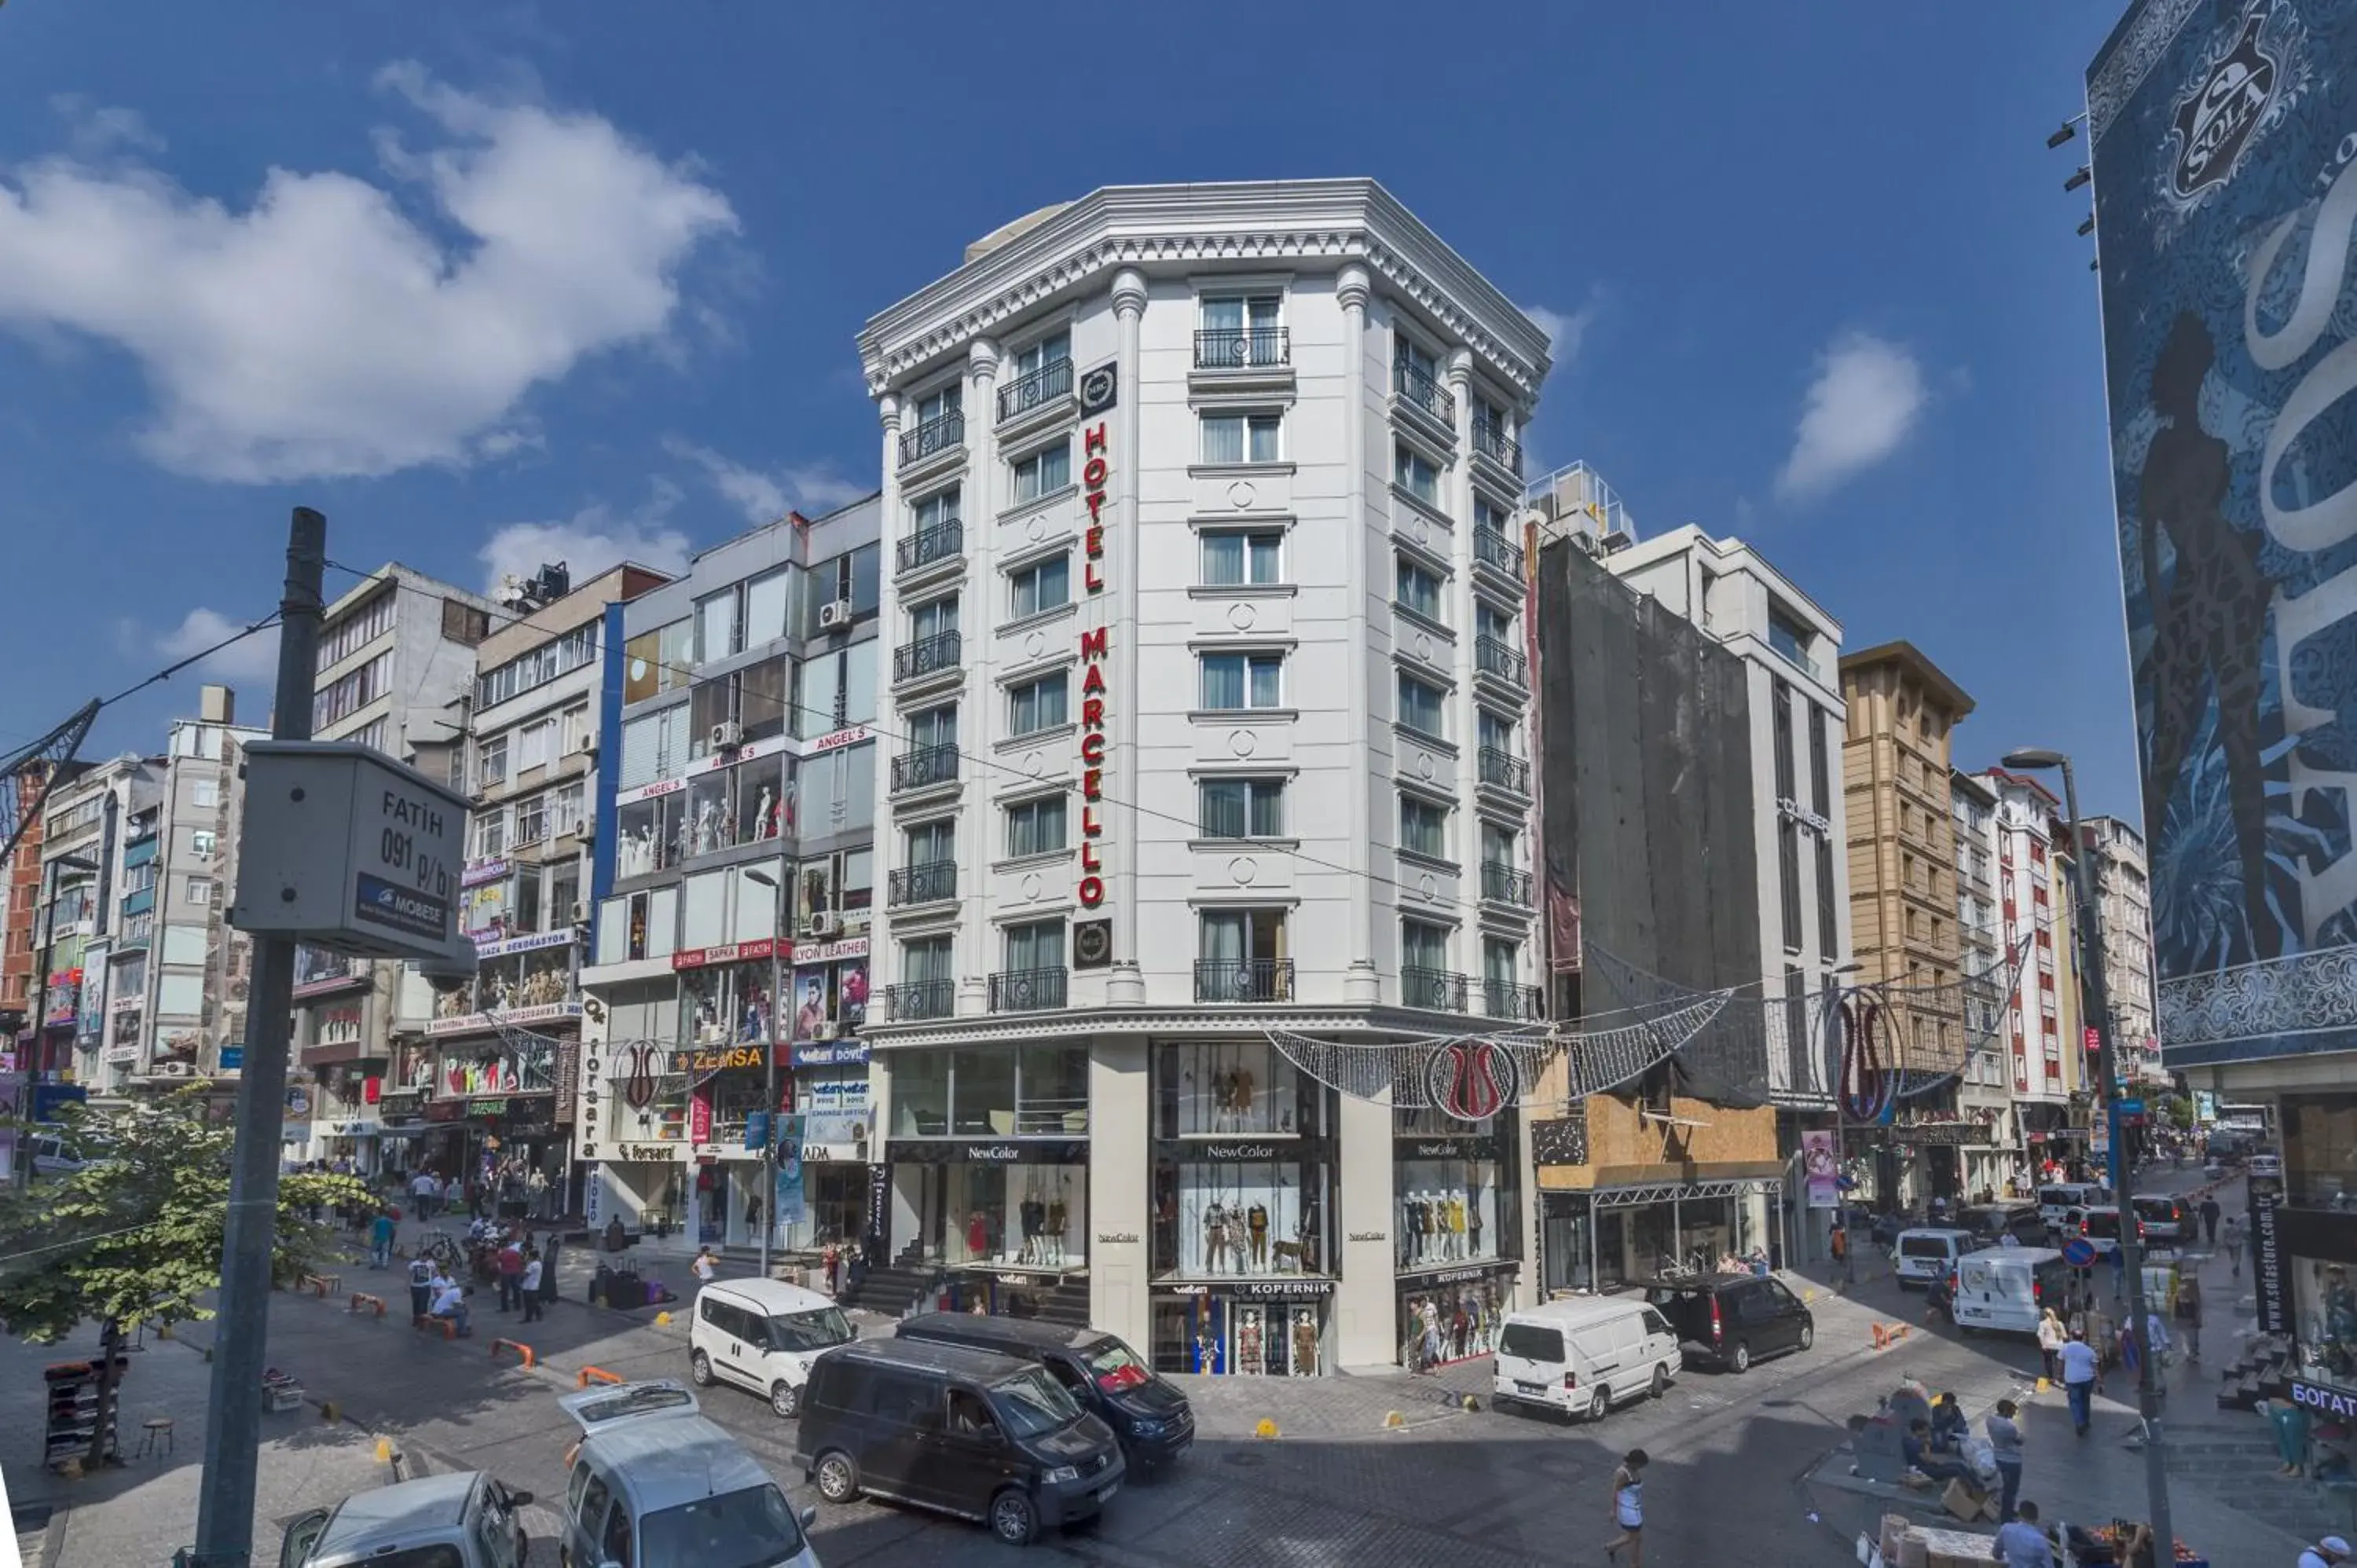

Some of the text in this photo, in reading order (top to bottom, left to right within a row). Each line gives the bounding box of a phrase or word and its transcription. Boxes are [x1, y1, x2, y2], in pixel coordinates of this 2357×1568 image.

[2187, 82, 2269, 185] SOLA
[1084, 420, 1107, 592] HOTEL
[817, 725, 866, 750] ANGEL'S
[1080, 626, 1108, 908] MARCELLO
[642, 779, 680, 798] ANGEL'S
[383, 789, 444, 839] FATİH
[381, 826, 413, 871] 091
[395, 894, 442, 923] MOBESE
[795, 940, 867, 962] LYON LEATHER
[968, 1146, 1019, 1160] NewColor
[1207, 1145, 1275, 1158] NewColor
[1419, 1144, 1457, 1156] NewColor
[1098, 1231, 1139, 1244] NewColor
